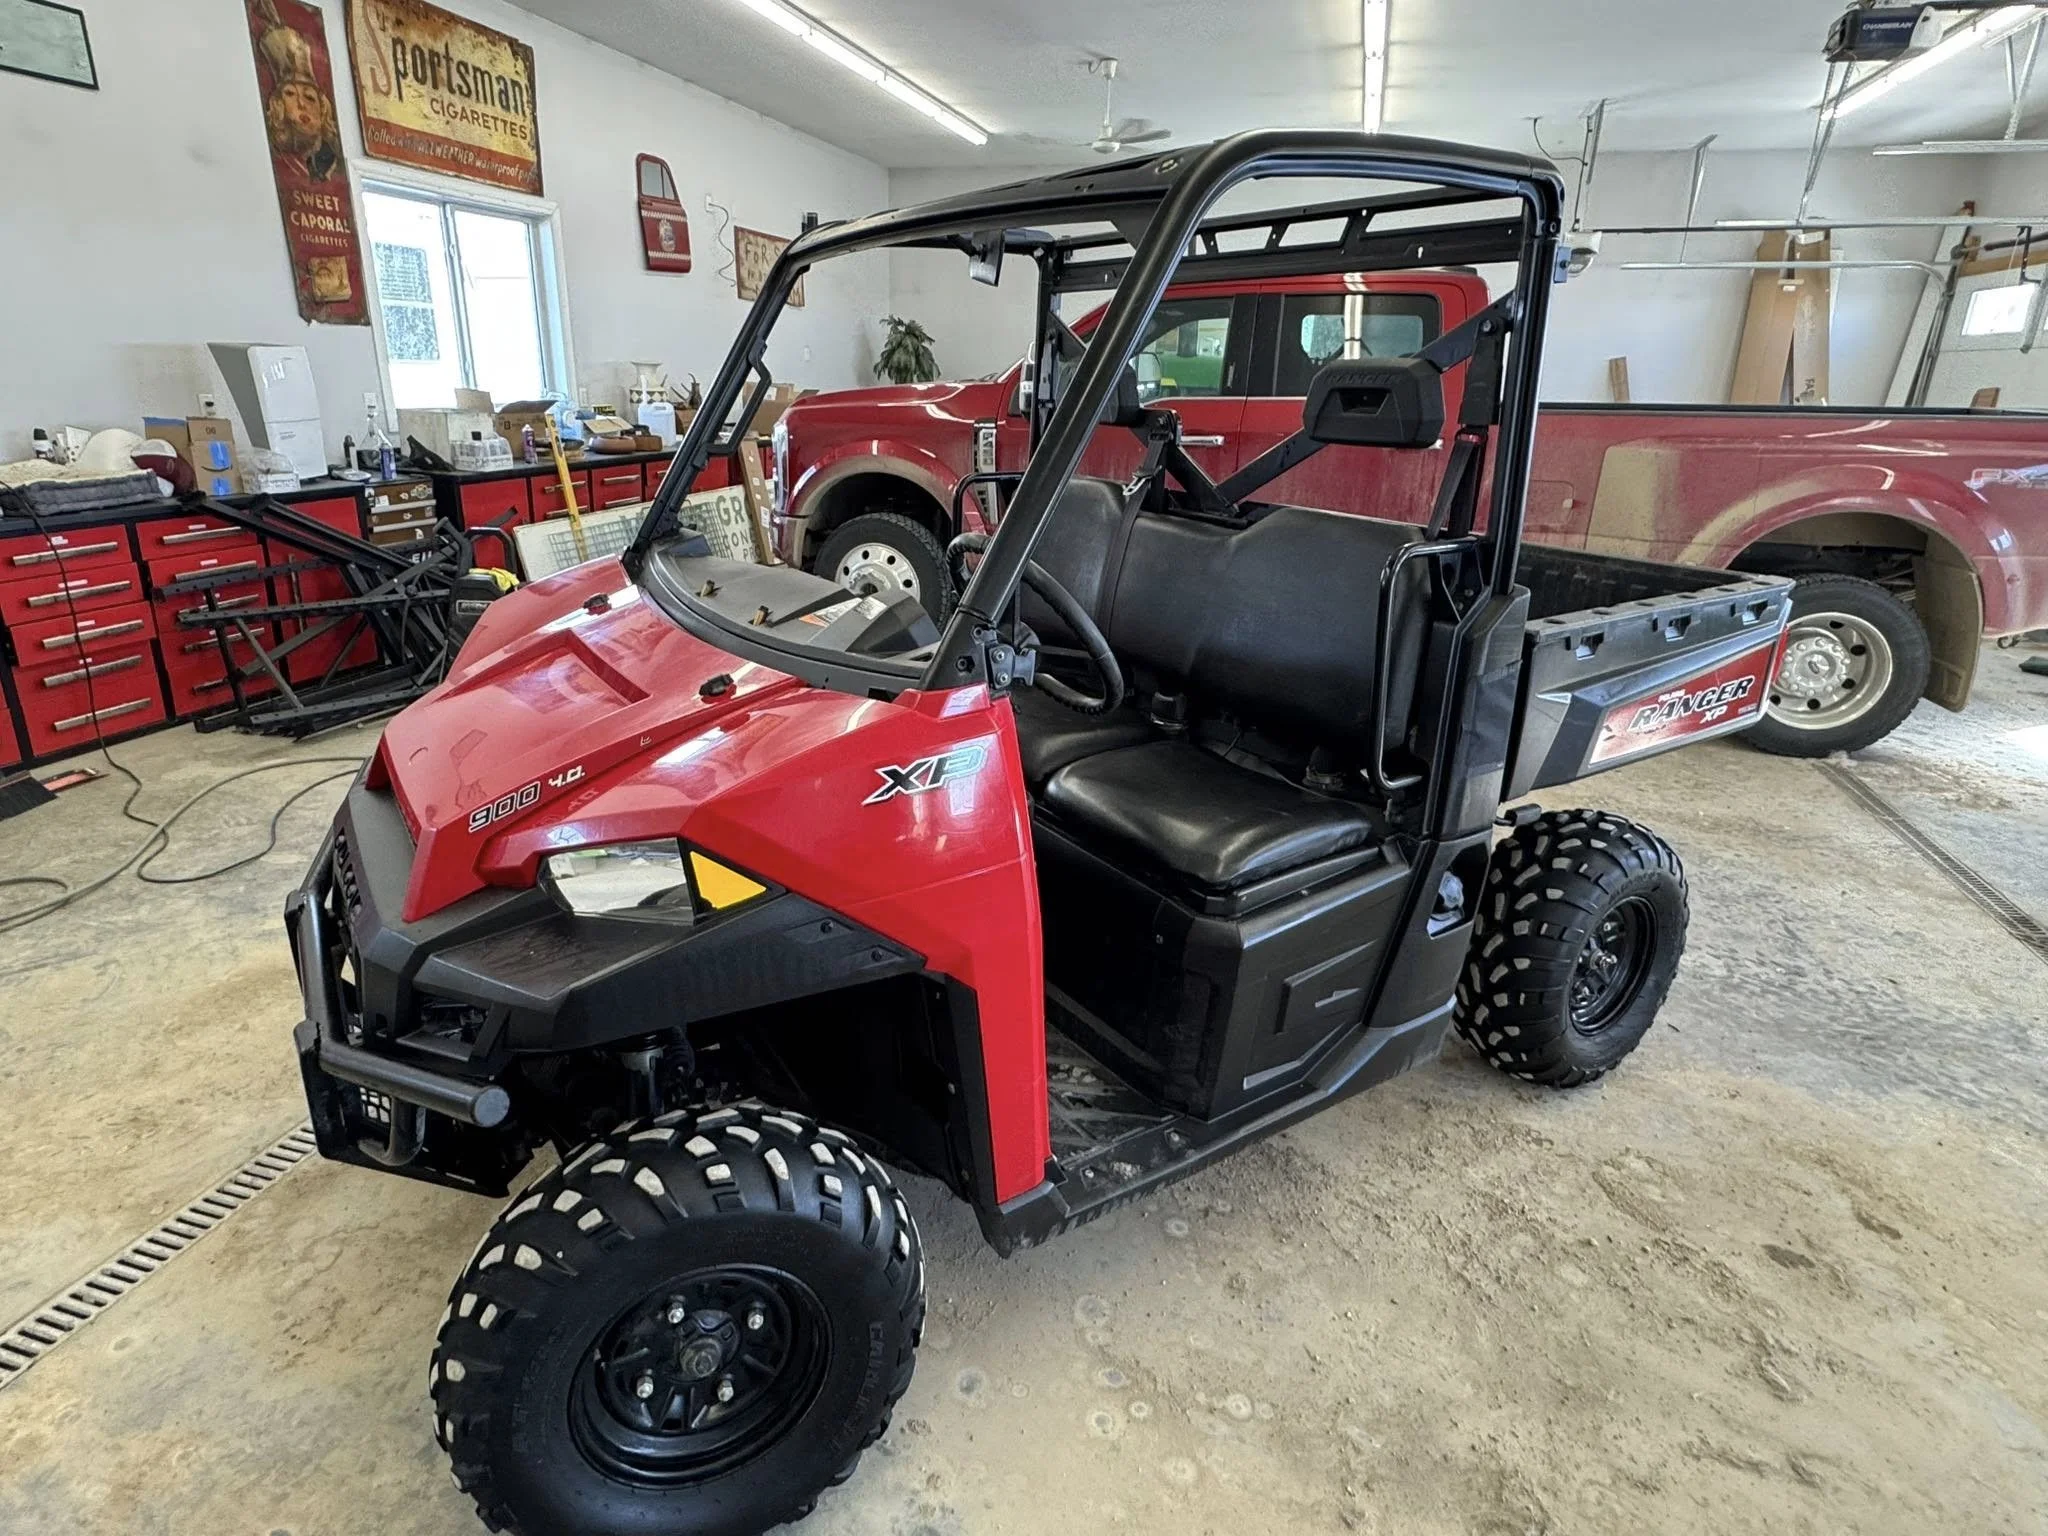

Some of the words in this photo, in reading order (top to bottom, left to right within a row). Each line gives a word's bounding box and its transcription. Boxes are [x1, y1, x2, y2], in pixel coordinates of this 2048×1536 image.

[430, 98, 528, 140] CIGARETTES
[292, 190, 340, 212] SWEET
[289, 211, 351, 234] CAPORAL
[1627, 675, 1755, 732] RANGER
[1699, 705, 1728, 724] XP
[861, 745, 985, 807] XP
[467, 780, 541, 833] 900
